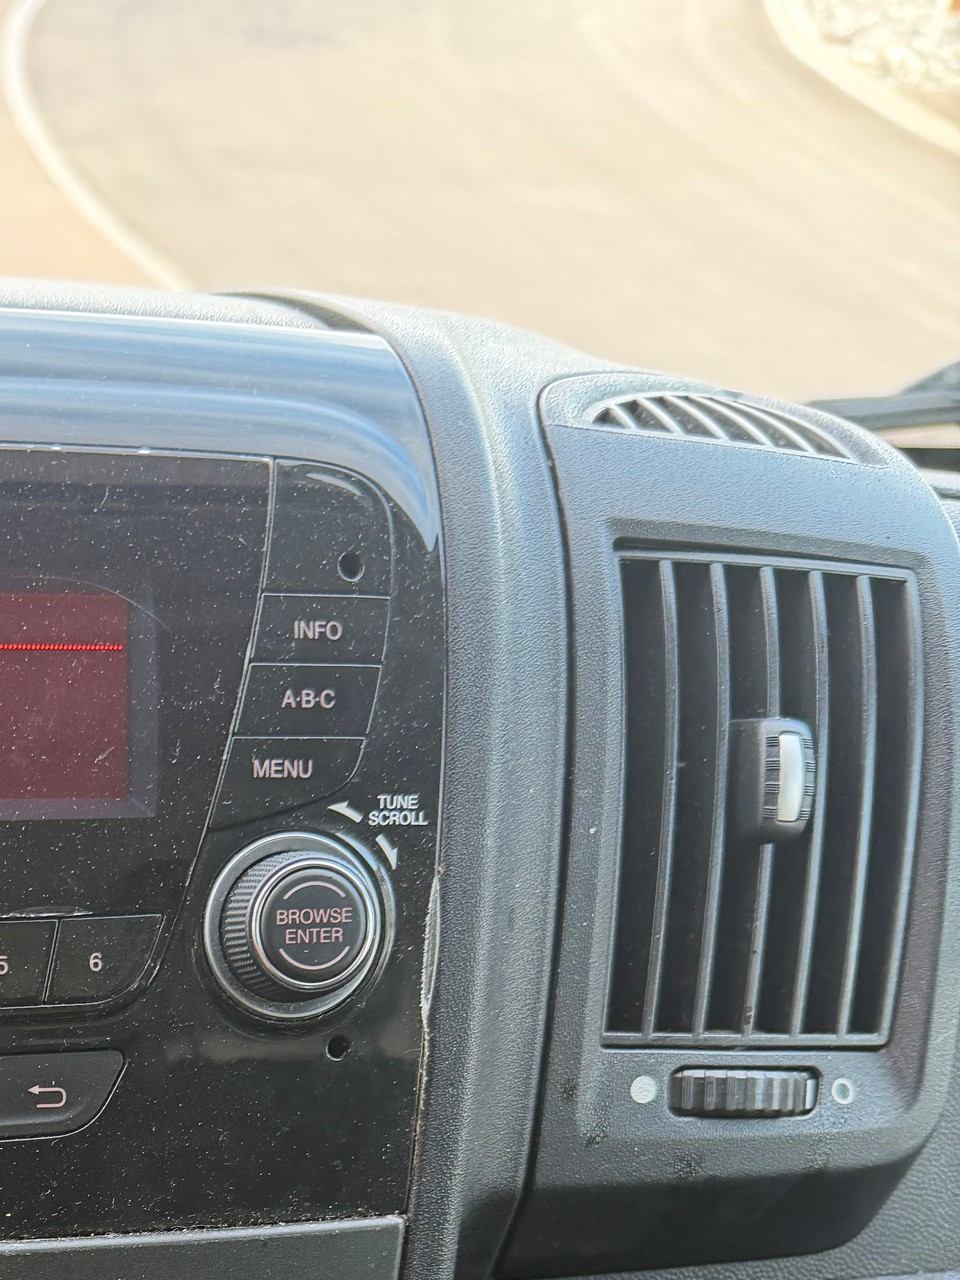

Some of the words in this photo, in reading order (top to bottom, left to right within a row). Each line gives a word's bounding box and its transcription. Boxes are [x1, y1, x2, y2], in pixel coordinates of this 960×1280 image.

[293, 620, 343, 641] INFO
[252, 759, 313, 779] MENU
[376, 794, 419, 811] TUNE
[368, 810, 429, 827] SCROLL
[275, 907, 353, 926] BROWSE
[284, 927, 344, 945] ENTER
[88, 952, 103, 973] 6
